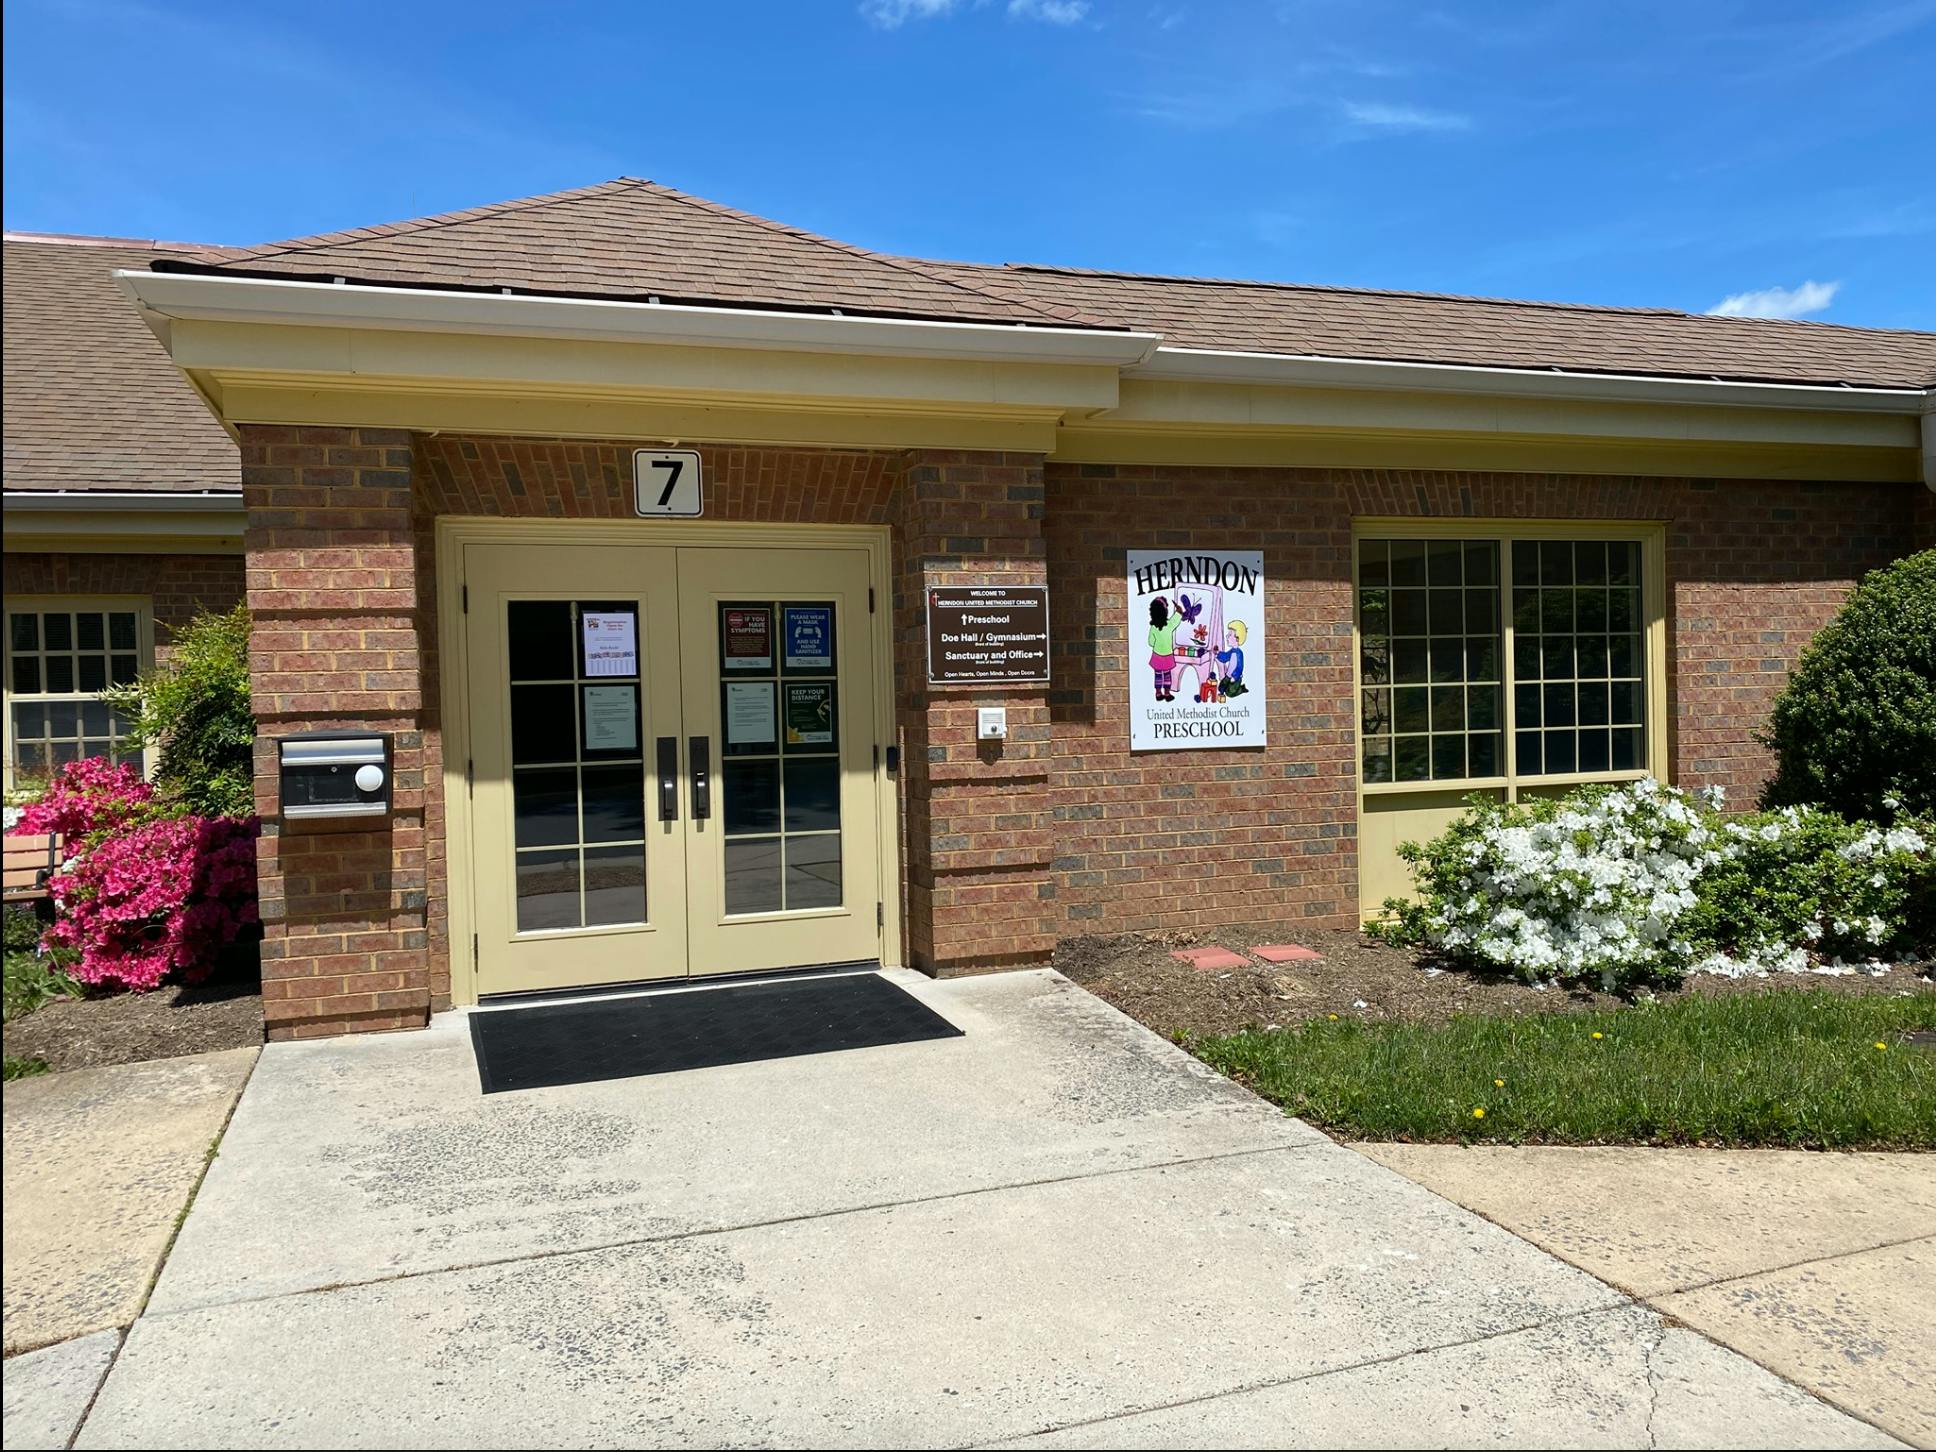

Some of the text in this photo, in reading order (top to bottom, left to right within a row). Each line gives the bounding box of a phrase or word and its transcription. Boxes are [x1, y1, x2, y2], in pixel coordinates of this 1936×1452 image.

[651, 460, 684, 506] 7
[1134, 556, 1259, 596] HERNDON
[968, 615, 1010, 624] Preschool
[941, 633, 959, 642] Doe
[961, 633, 978, 642] Hall
[986, 632, 1036, 643] Gymnasium
[945, 650, 1034, 661] Sanctuary and Office
[1147, 706, 1250, 720] United Methodist Church
[1154, 720, 1244, 739] PRESCHOOL
